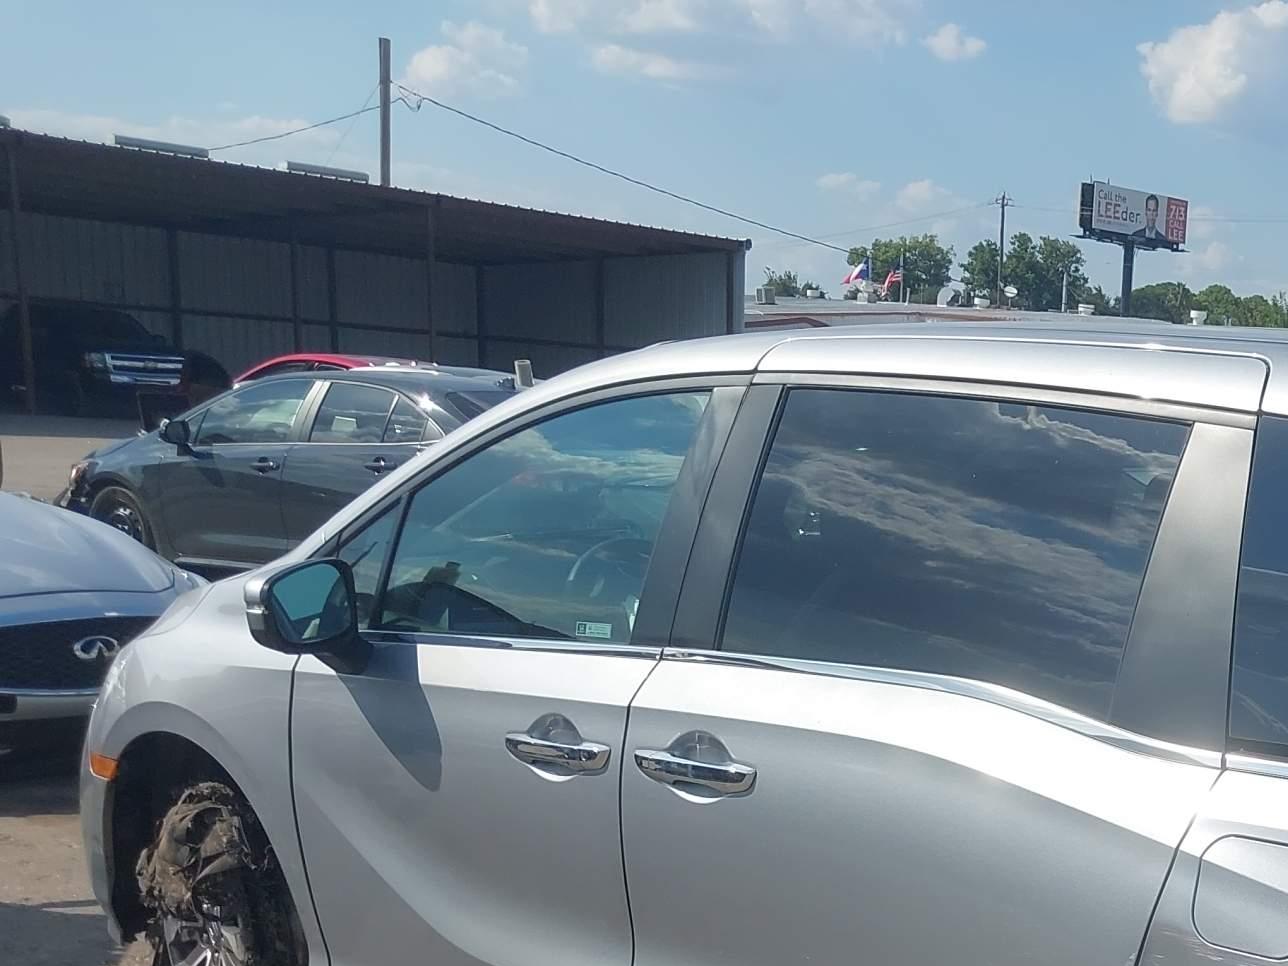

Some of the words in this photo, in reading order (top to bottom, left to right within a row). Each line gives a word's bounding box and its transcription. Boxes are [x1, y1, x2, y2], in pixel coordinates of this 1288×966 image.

[1098, 189, 1112, 201] Call
[1169, 204, 1185, 221] 713
[1168, 228, 1185, 242] LEE
